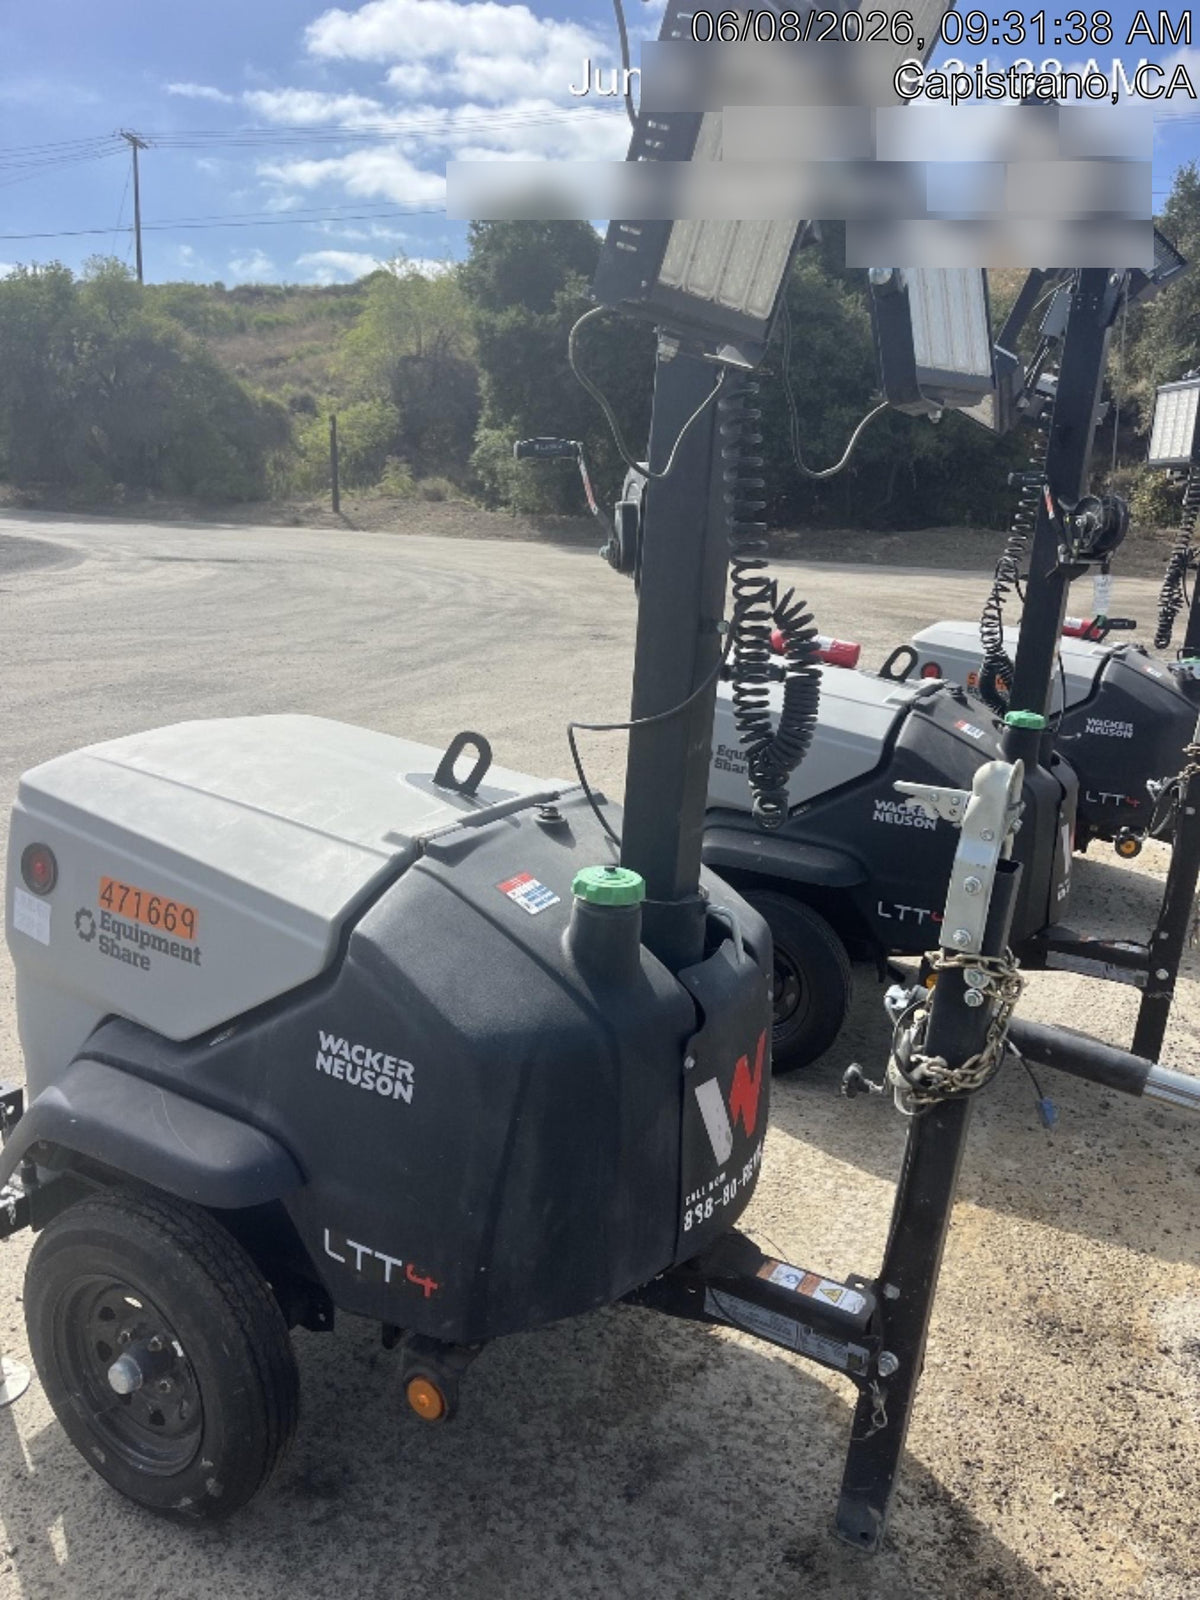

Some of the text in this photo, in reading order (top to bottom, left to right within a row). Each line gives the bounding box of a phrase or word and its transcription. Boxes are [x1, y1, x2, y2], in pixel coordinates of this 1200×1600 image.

[873, 810, 937, 831] NEUSON
[100, 881, 195, 940] 471669
[99, 911, 202, 967] Equipment
[99, 935, 151, 971] Share
[315, 1051, 413, 1104] NEUSON
[318, 1030, 415, 1083] WACKER
[323, 1228, 438, 1298] LTT4
